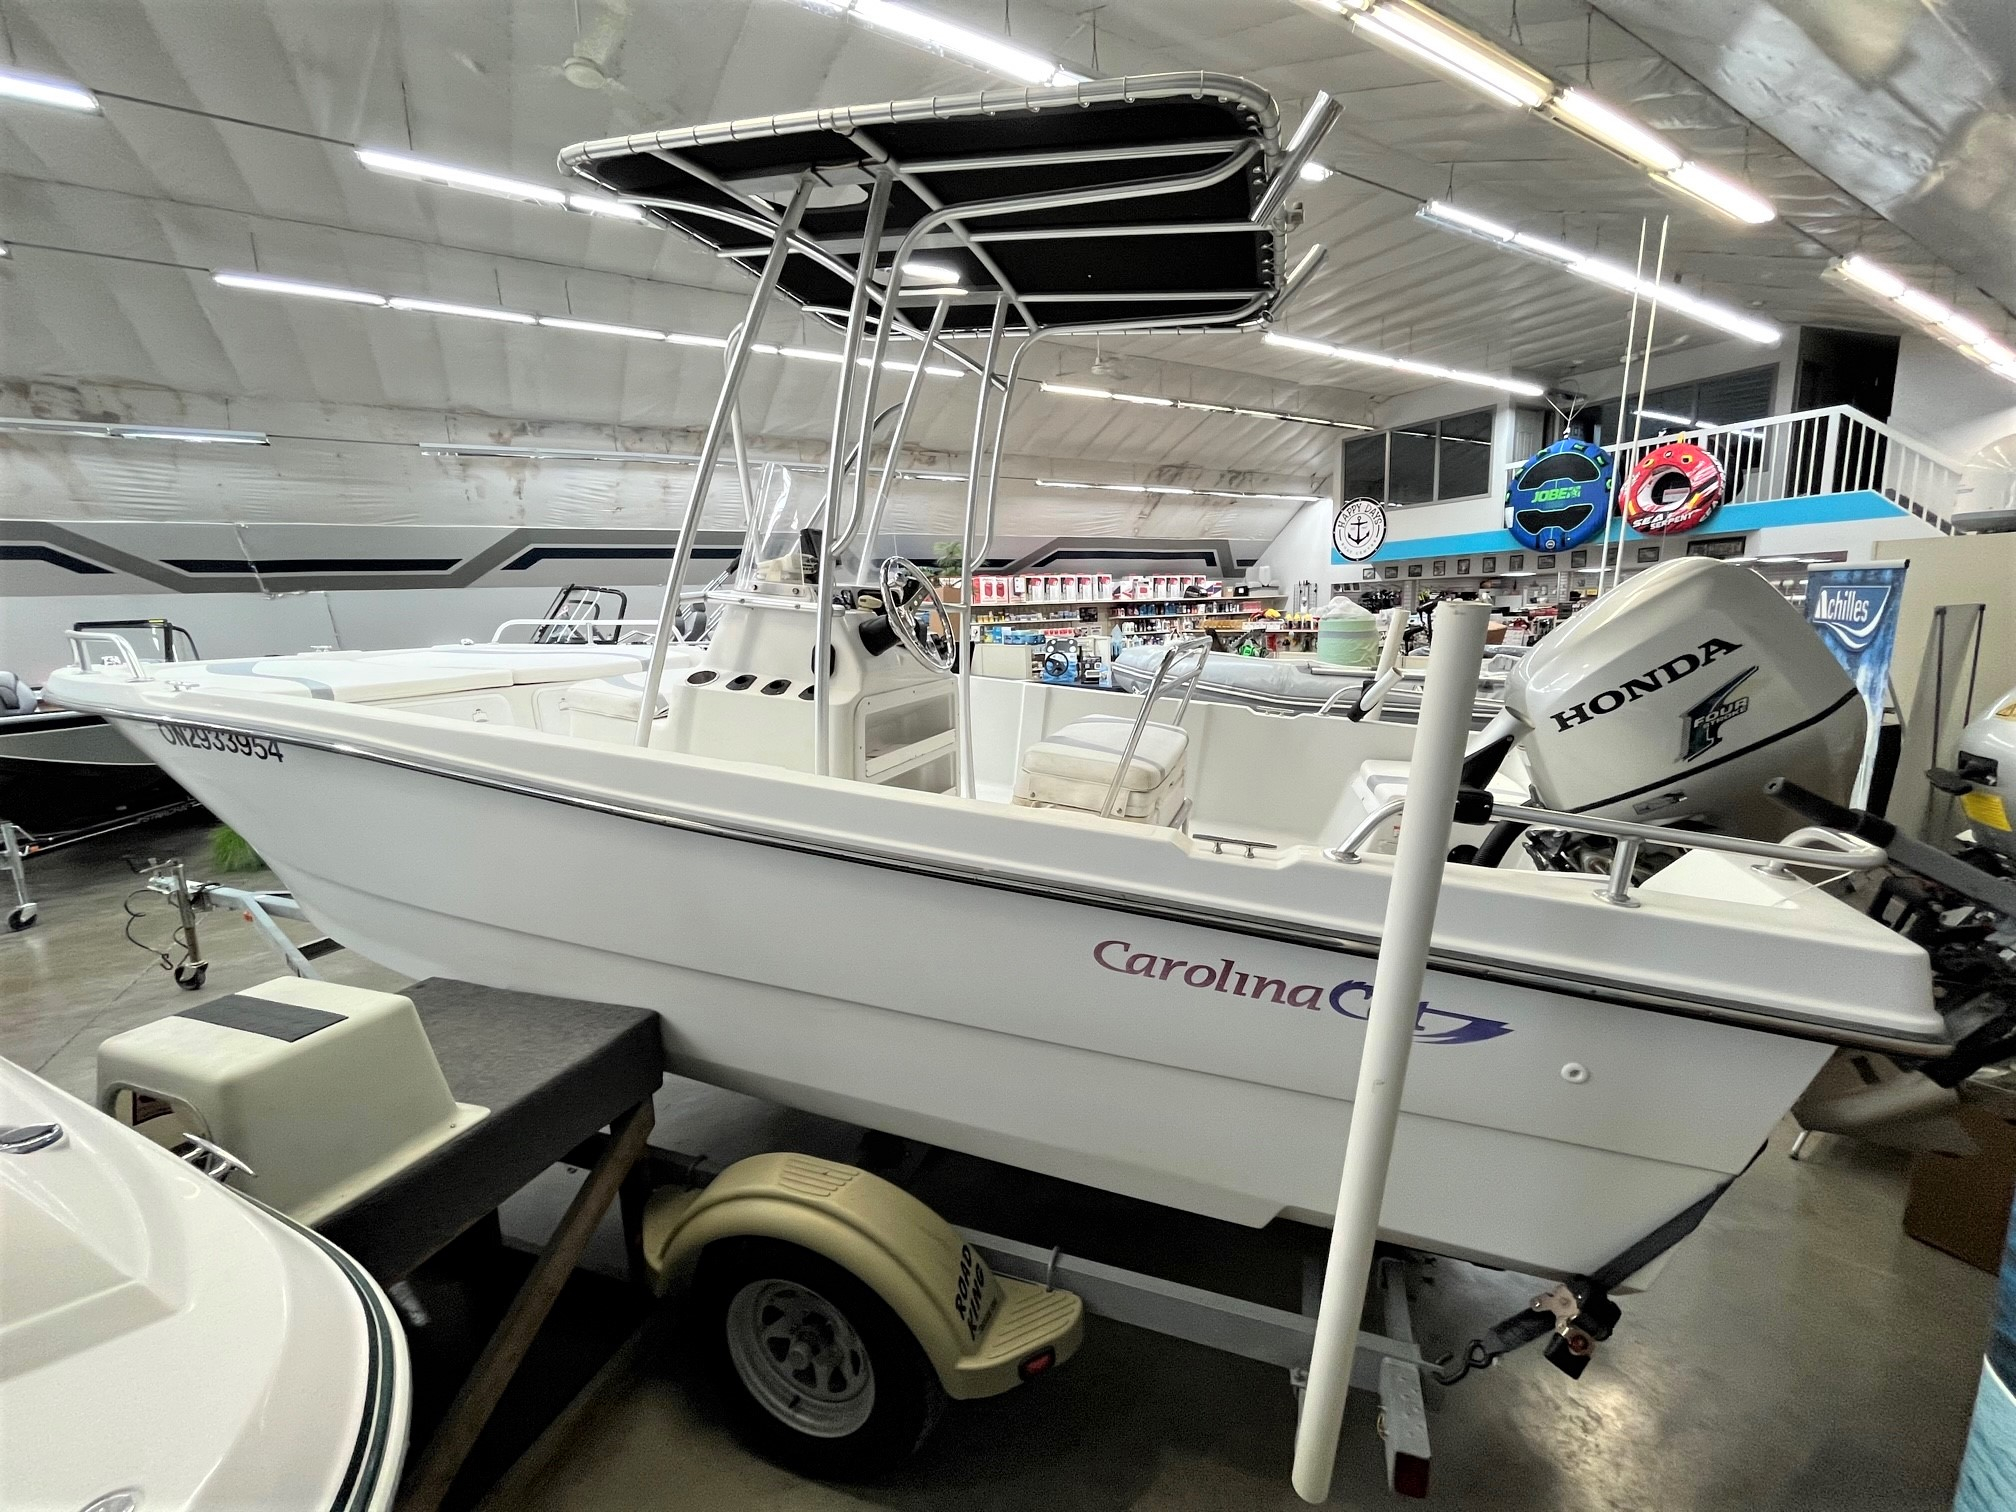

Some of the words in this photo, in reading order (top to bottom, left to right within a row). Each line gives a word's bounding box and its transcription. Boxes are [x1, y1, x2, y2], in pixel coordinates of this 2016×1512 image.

[1531, 487, 1569, 504] JOBE
[1338, 503, 1362, 528] HAPPY
[1365, 504, 1382, 525] DAYS
[1633, 513, 1664, 528] SEA
[1814, 590, 1869, 622] Achilles
[1550, 638, 1743, 732] HONDA
[1693, 698, 1748, 728] FOUR
[157, 723, 284, 763] ON2933954
[1093, 940, 1324, 1011] Carolina
[956, 1245, 972, 1320] ROAD
[968, 1263, 985, 1341] KING
